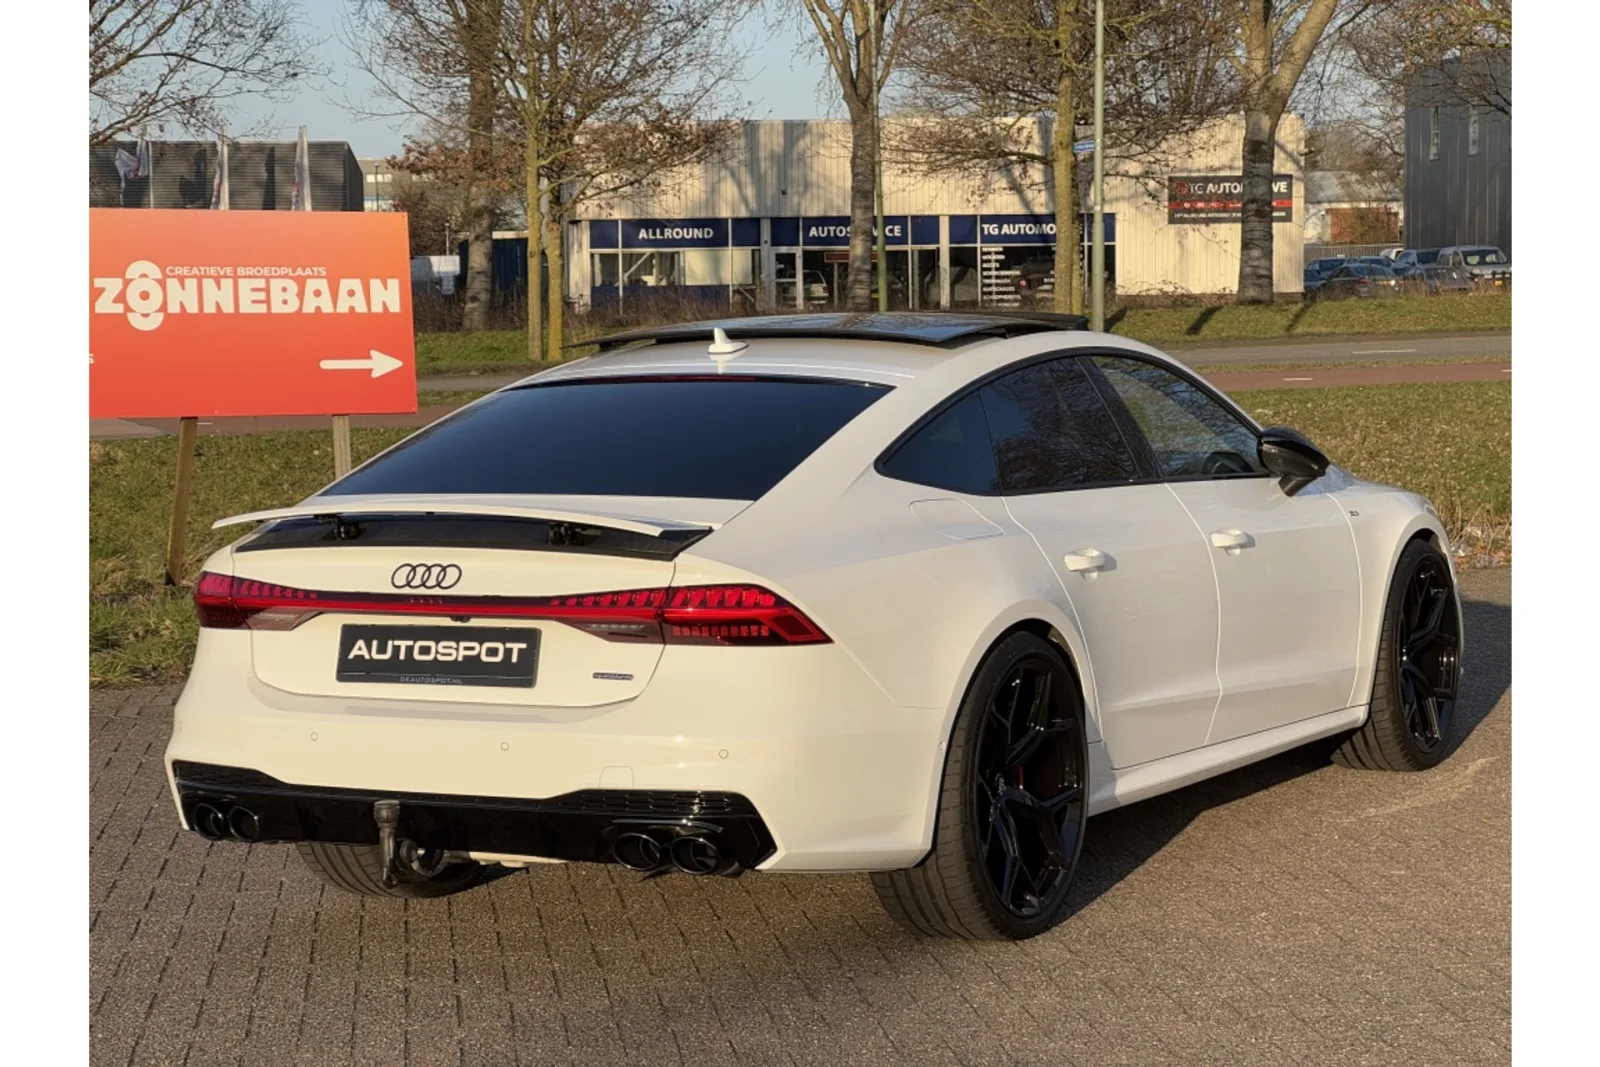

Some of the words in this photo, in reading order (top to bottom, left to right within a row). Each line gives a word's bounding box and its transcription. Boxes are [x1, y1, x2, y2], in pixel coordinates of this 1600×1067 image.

[1206, 182, 1288, 194] AUTOVE
[638, 228, 714, 240] ALLROUND
[982, 223, 999, 235] TG
[1001, 223, 1083, 235] AUTOMO
[166, 266, 234, 277] CREATIEVE
[237, 266, 327, 277] BROEDPLAATS
[93, 259, 401, 331] ZONNEBAAN
[348, 639, 527, 664] AUTOSPOT
